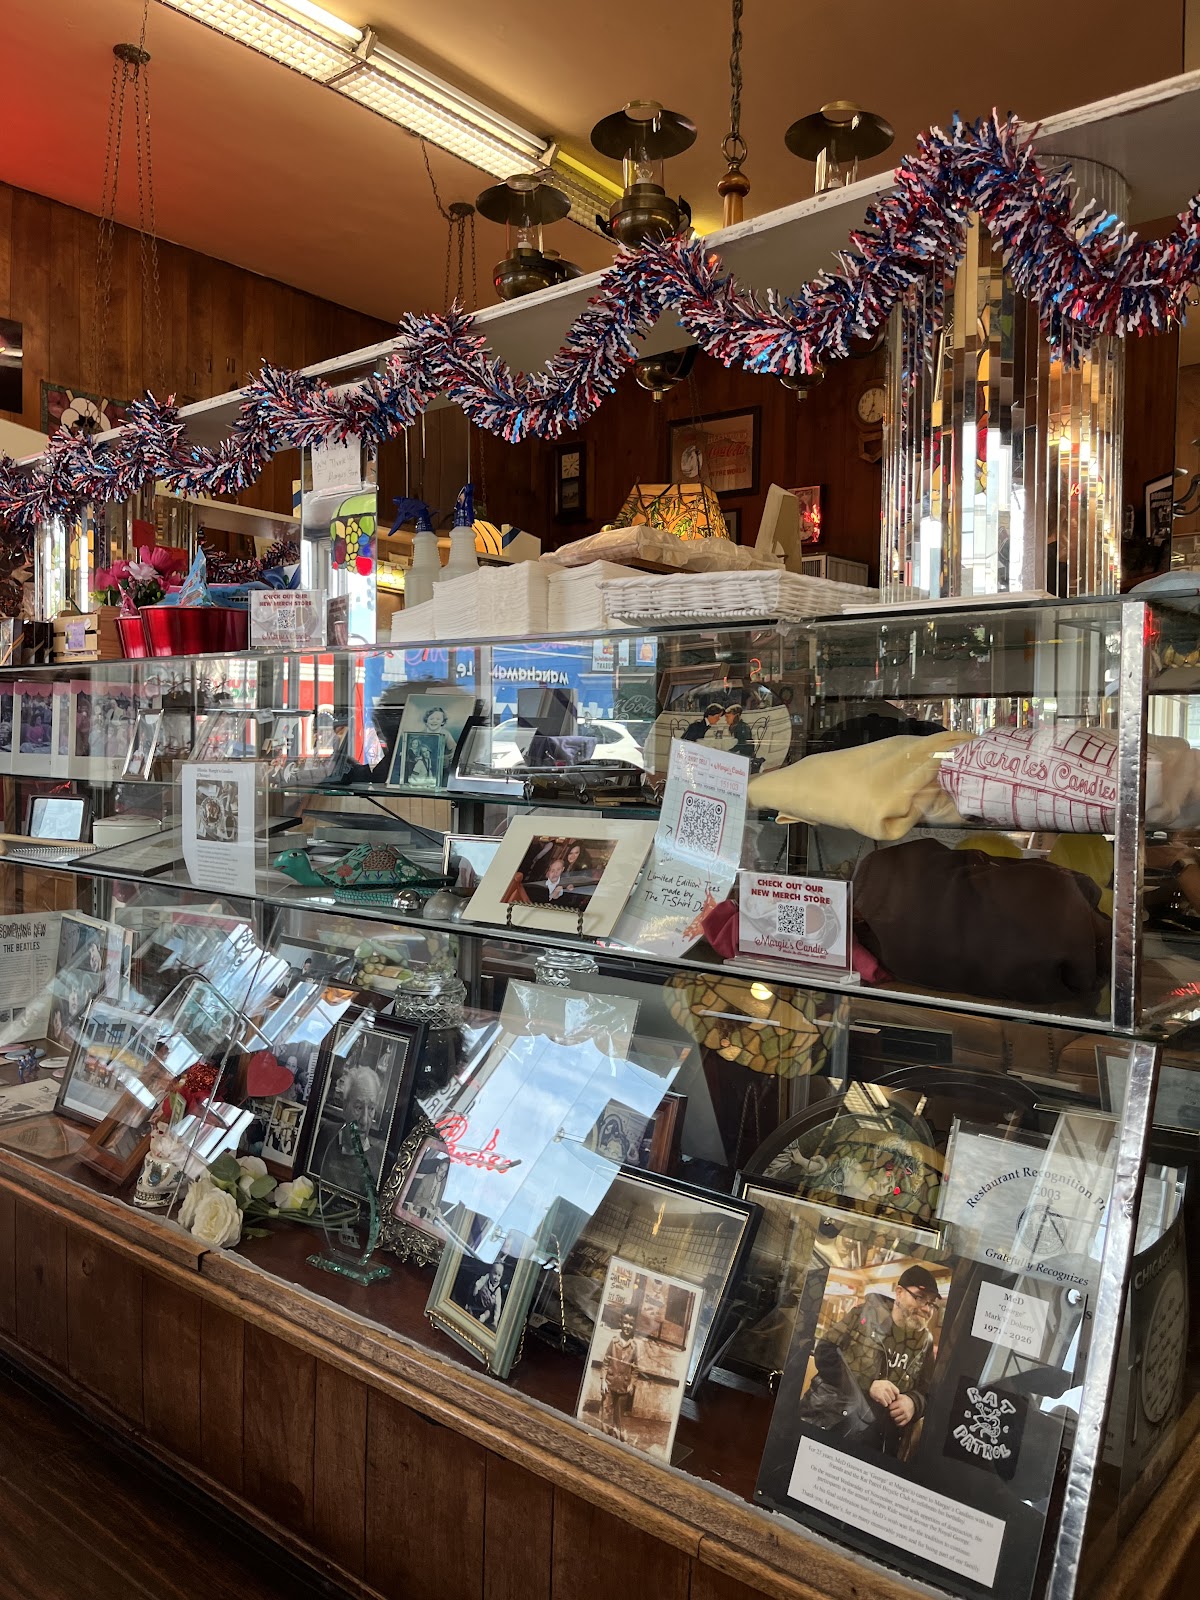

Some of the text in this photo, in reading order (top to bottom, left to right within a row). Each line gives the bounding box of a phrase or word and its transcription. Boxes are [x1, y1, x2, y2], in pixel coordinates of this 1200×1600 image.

[950, 739, 1117, 801] Margie's Candies
[720, 779, 739, 791] 151103
[647, 870, 720, 893] Limited Edition Tees
[757, 879, 824, 893] CHECK OUT OUR
[644, 890, 704, 913] The T-Shirt De
[661, 888, 695, 901] made by
[751, 888, 831, 905] NEW MERCH STORE
[3, 941, 40, 953] THE BEATLES
[754, 934, 829, 956] Margie's Candies
[966, 1169, 1021, 1209] Restaurant
[1022, 1166, 1093, 1200] Recognition
[1033, 1185, 1061, 1201] 2003
[985, 1247, 1089, 1287] Gratefully Recognizes
[1004, 1292, 1025, 1306] McD
[984, 1310, 1001, 1321] Mark
[1010, 1319, 1036, 1333] Doherty
[983, 1323, 1002, 1335] 1971
[1009, 1332, 1033, 1345] 2026
[966, 1387, 1017, 1414] RAT
[952, 1424, 1012, 1461] PATROL
